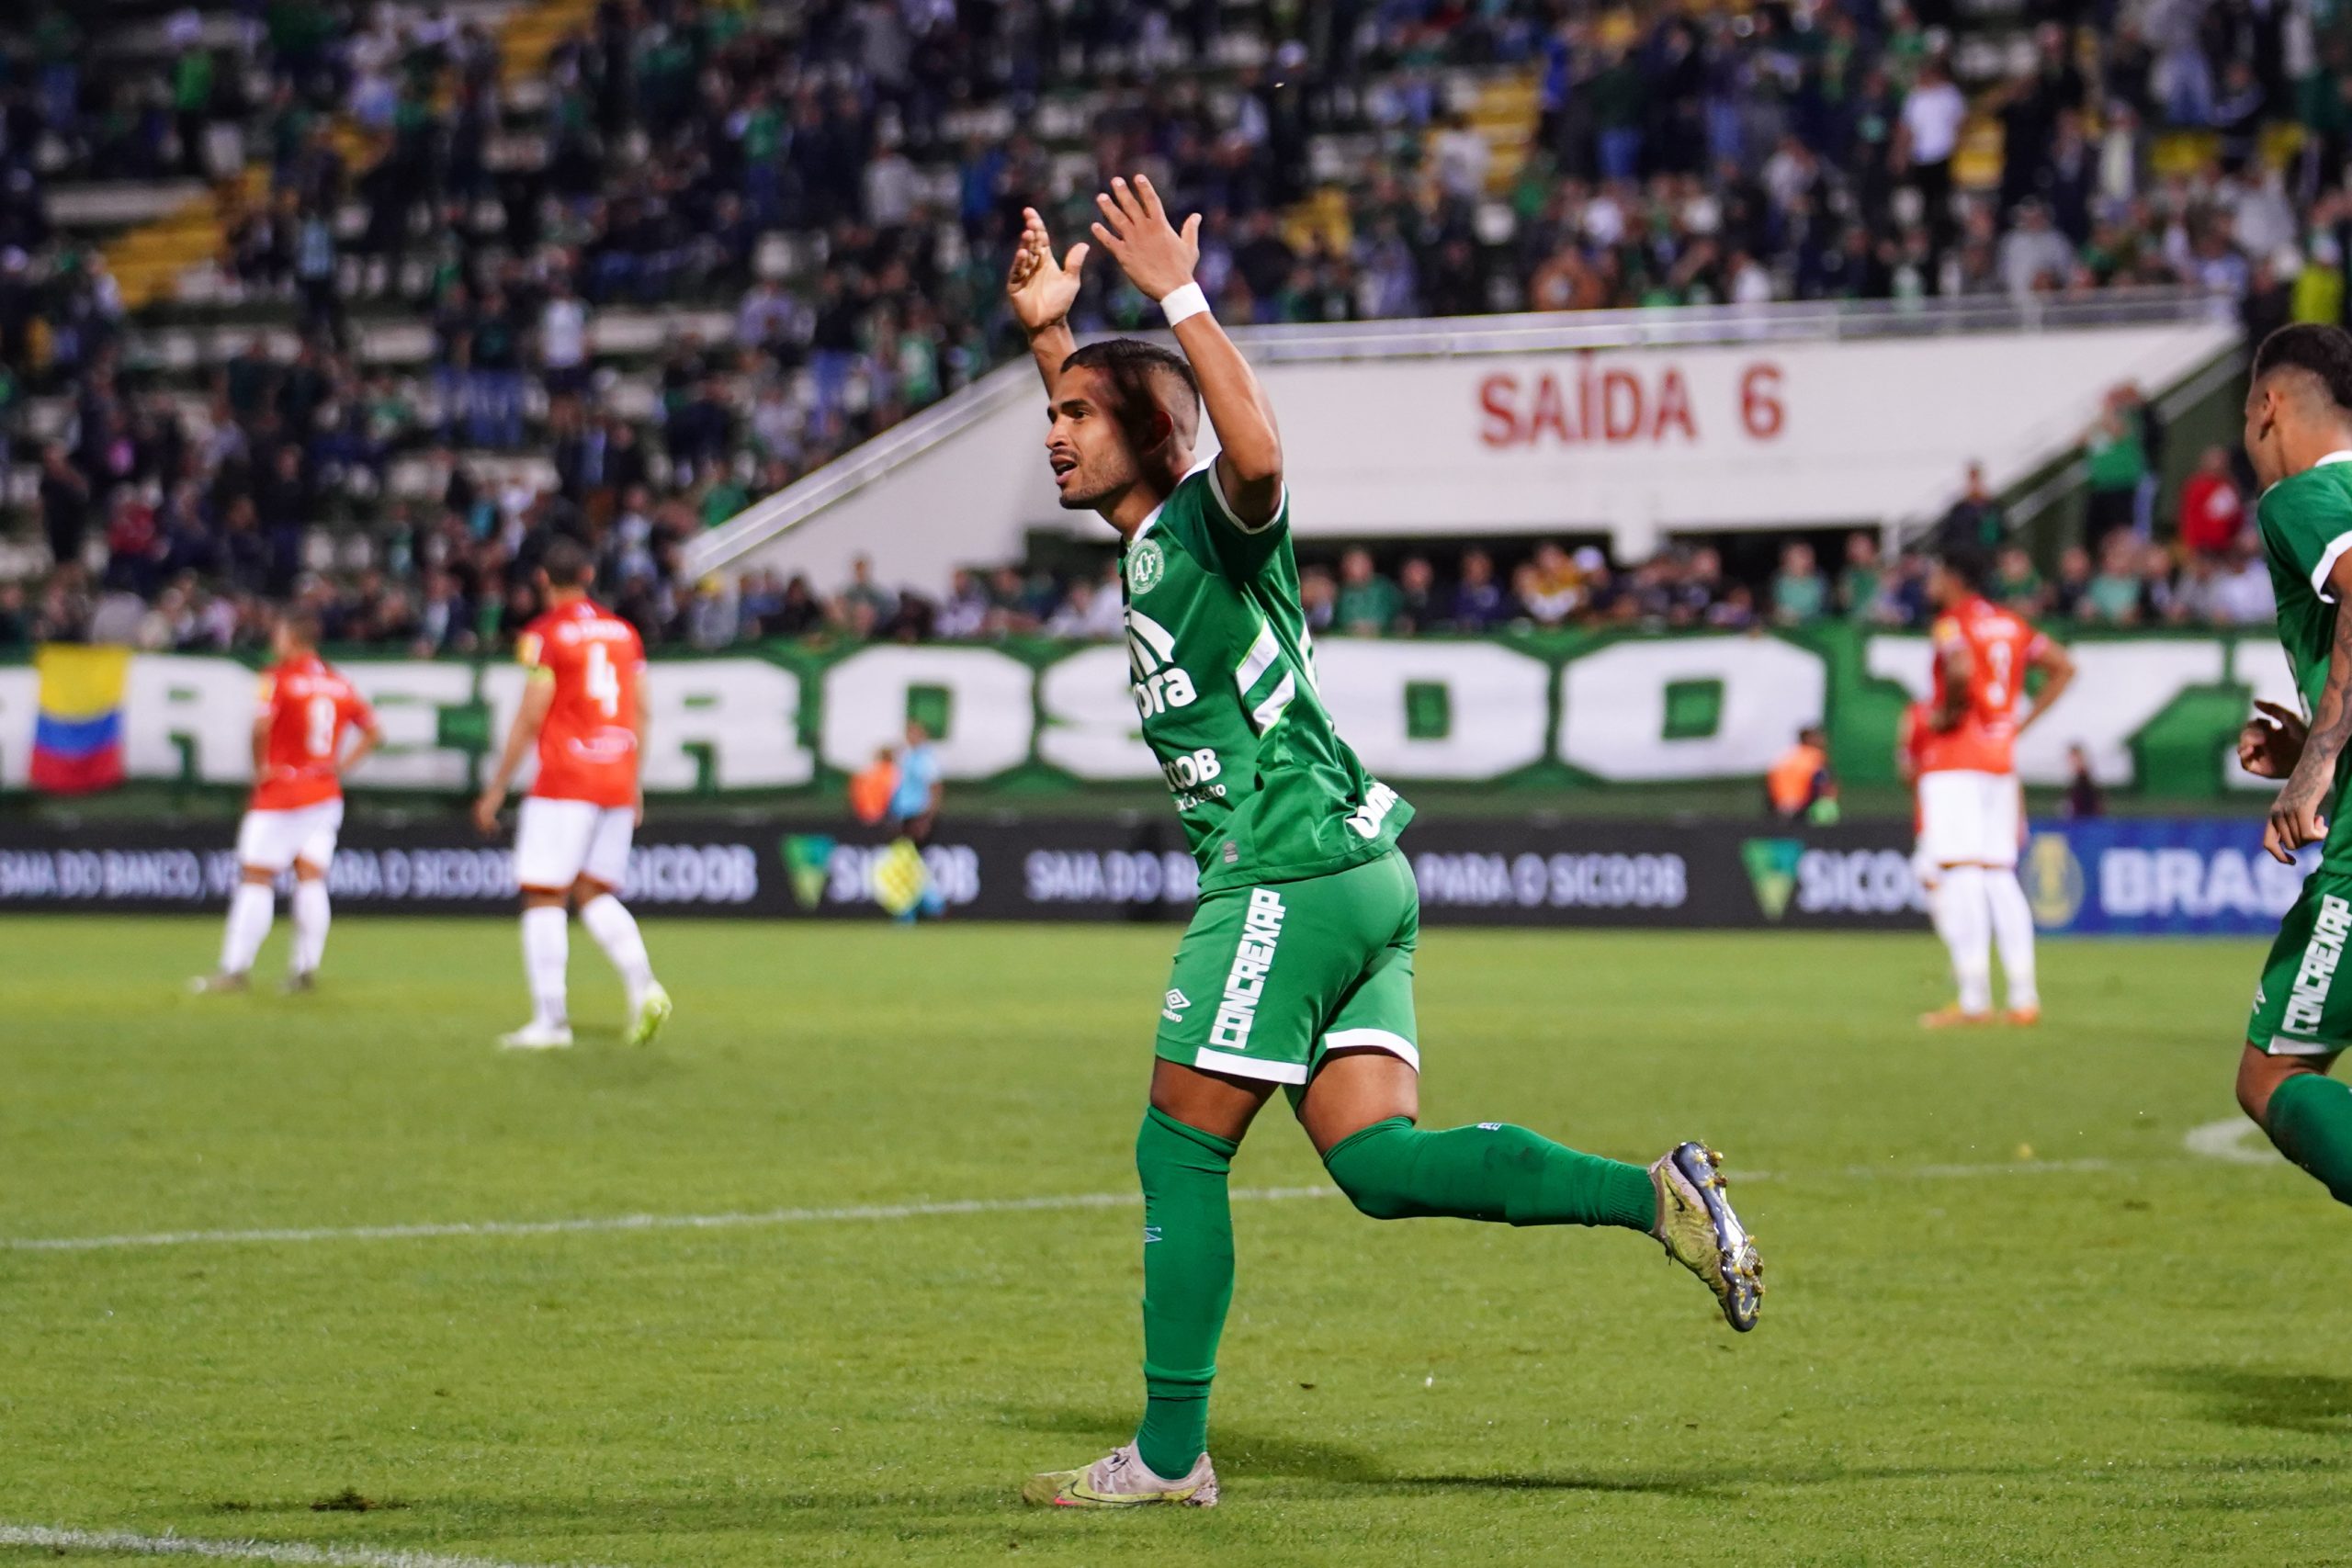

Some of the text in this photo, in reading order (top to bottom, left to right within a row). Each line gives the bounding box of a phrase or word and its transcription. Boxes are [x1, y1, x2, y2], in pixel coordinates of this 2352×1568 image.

[1479, 347, 1785, 448] SAÍDA 6
[584, 641, 621, 718] 4
[1133, 667, 1198, 720] ora
[326, 850, 383, 897] ARA
[1024, 850, 1106, 903] SAIA
[1103, 850, 1162, 903] DO
[1416, 852, 1688, 908] PARA O SICOOB
[1209, 887, 1286, 1049] CONCREXAP
